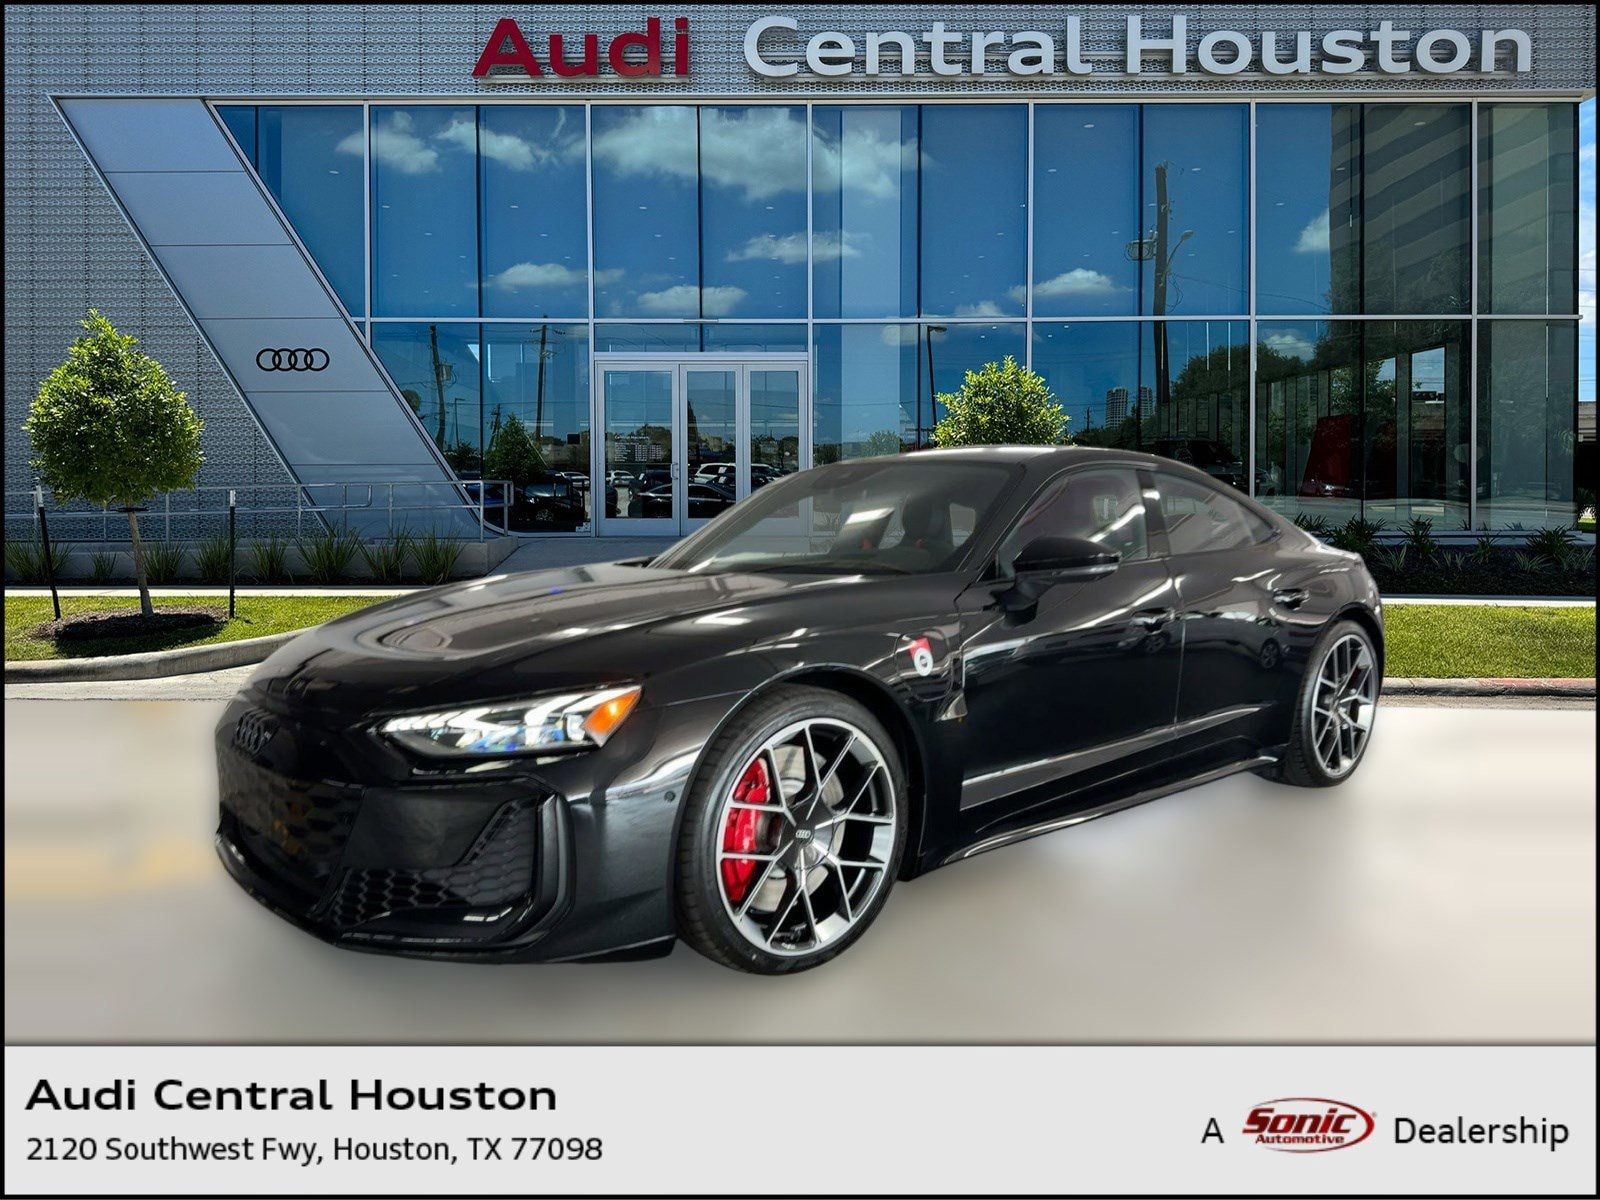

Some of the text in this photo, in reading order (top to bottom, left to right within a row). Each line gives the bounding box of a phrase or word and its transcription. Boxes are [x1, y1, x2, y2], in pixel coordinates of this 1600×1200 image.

[471, 14, 1532, 78] Audi Central Houston
